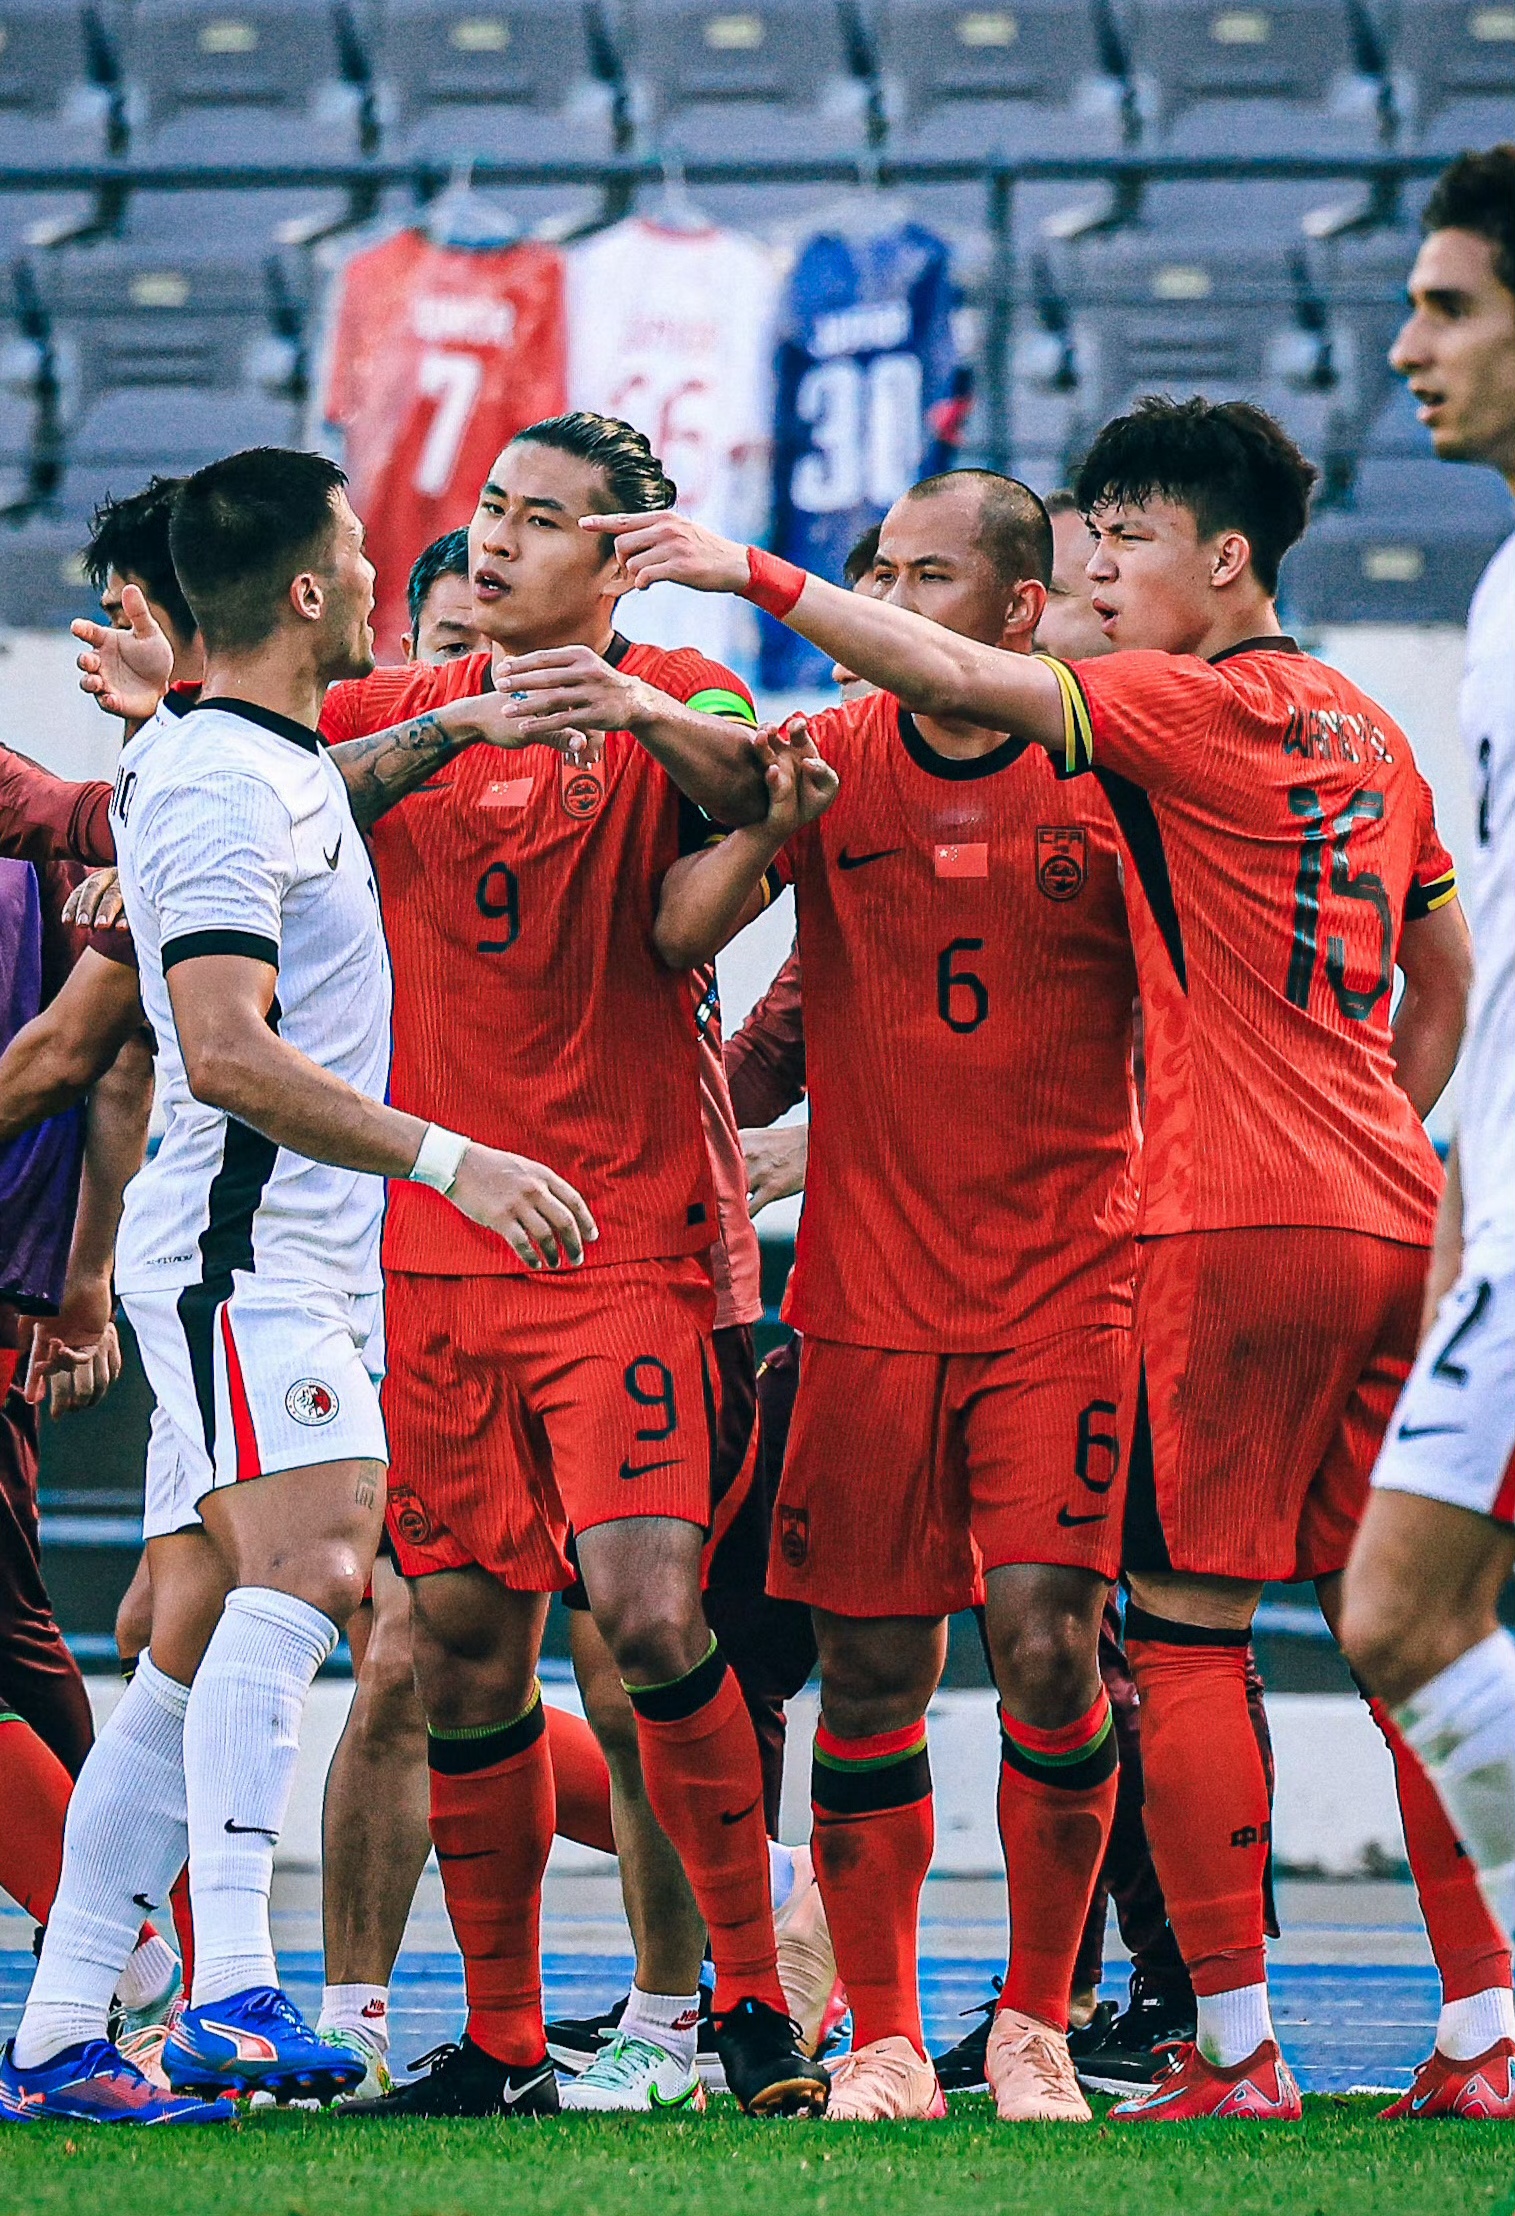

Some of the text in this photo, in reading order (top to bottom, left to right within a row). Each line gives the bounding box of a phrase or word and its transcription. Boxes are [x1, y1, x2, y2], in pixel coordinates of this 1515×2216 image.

[416, 355, 483, 496] 7
[792, 357, 924, 512] 30
[476, 862, 520, 954] 9
[1286, 787, 1393, 1021] 15
[938, 938, 988, 1034] 6
[1432, 1276, 1491, 1388] 2
[624, 1355, 678, 1442] 9
[1075, 1399, 1120, 1494] 6
